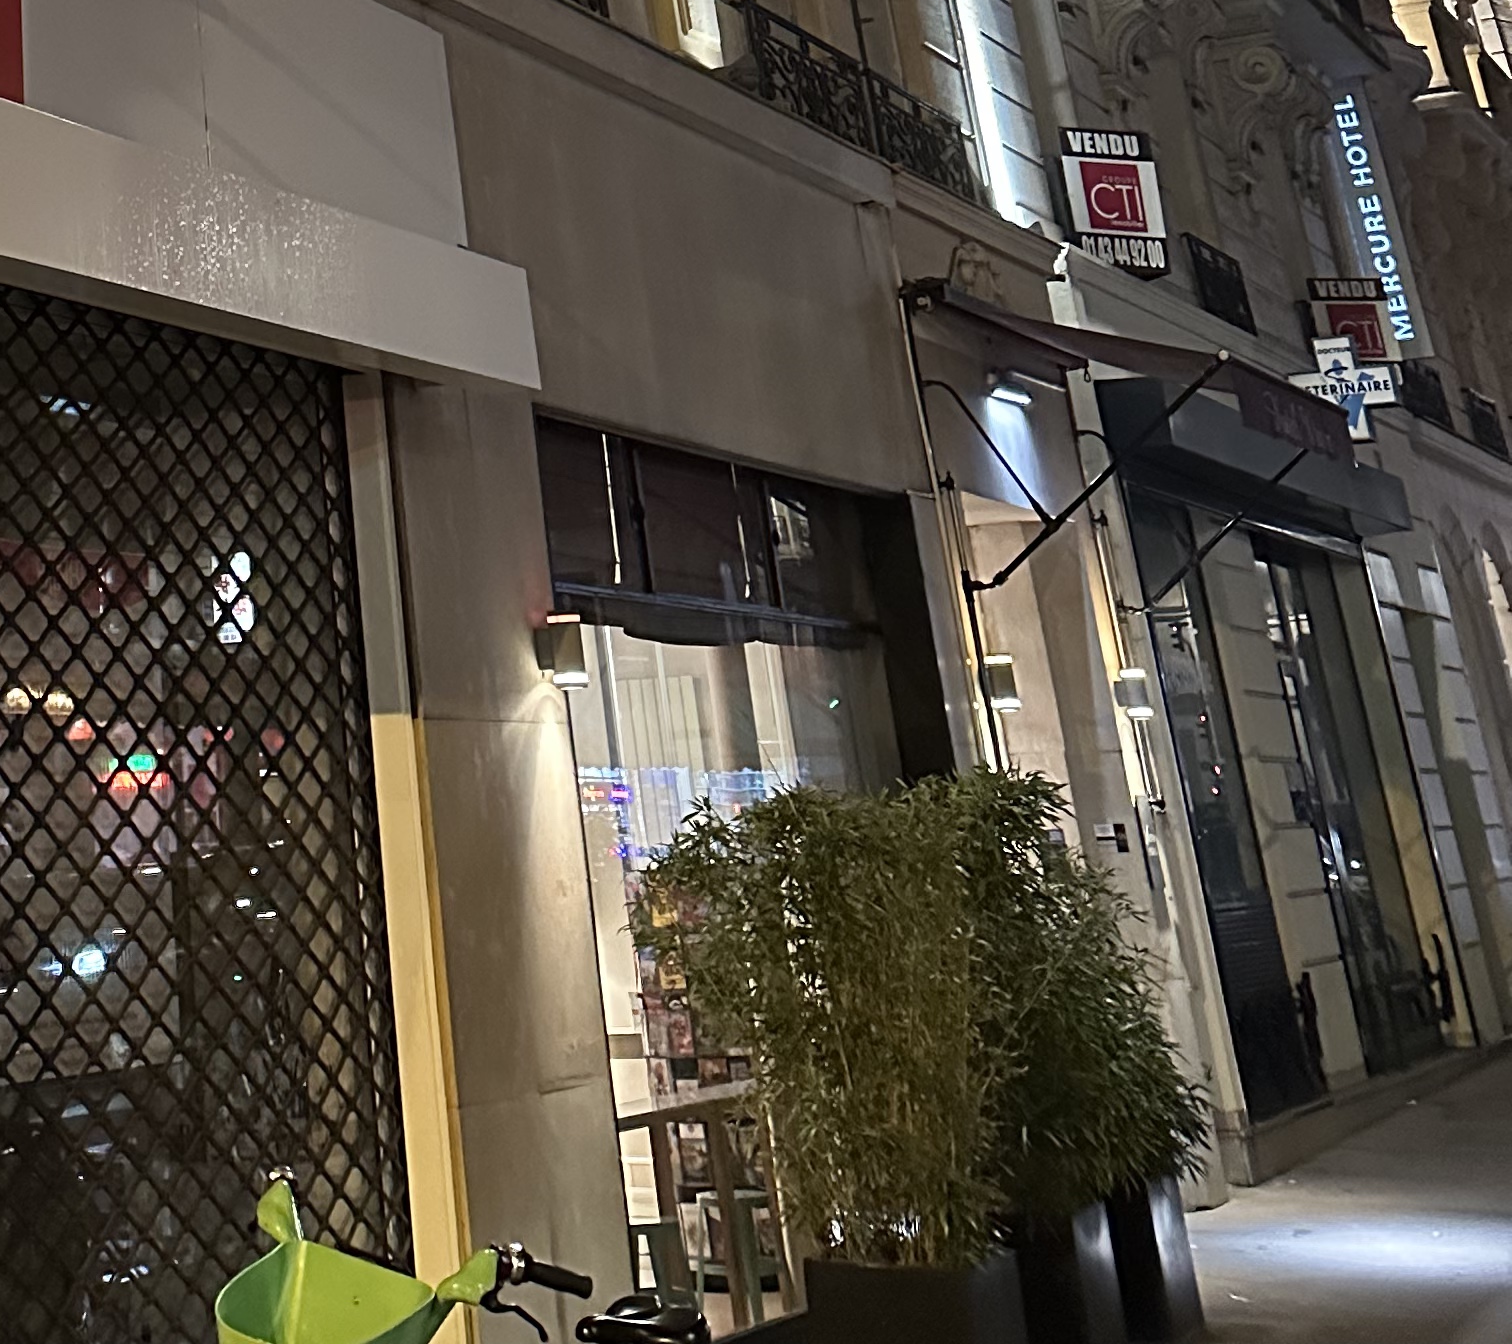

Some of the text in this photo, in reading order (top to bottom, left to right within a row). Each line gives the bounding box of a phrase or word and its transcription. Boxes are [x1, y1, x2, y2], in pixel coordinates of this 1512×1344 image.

[1066, 130, 1140, 157] VENDU
[1090, 183, 1144, 221] CTI
[1333, 94, 1415, 342] MERCURE HOTEL
[1313, 280, 1377, 298] VENDU
